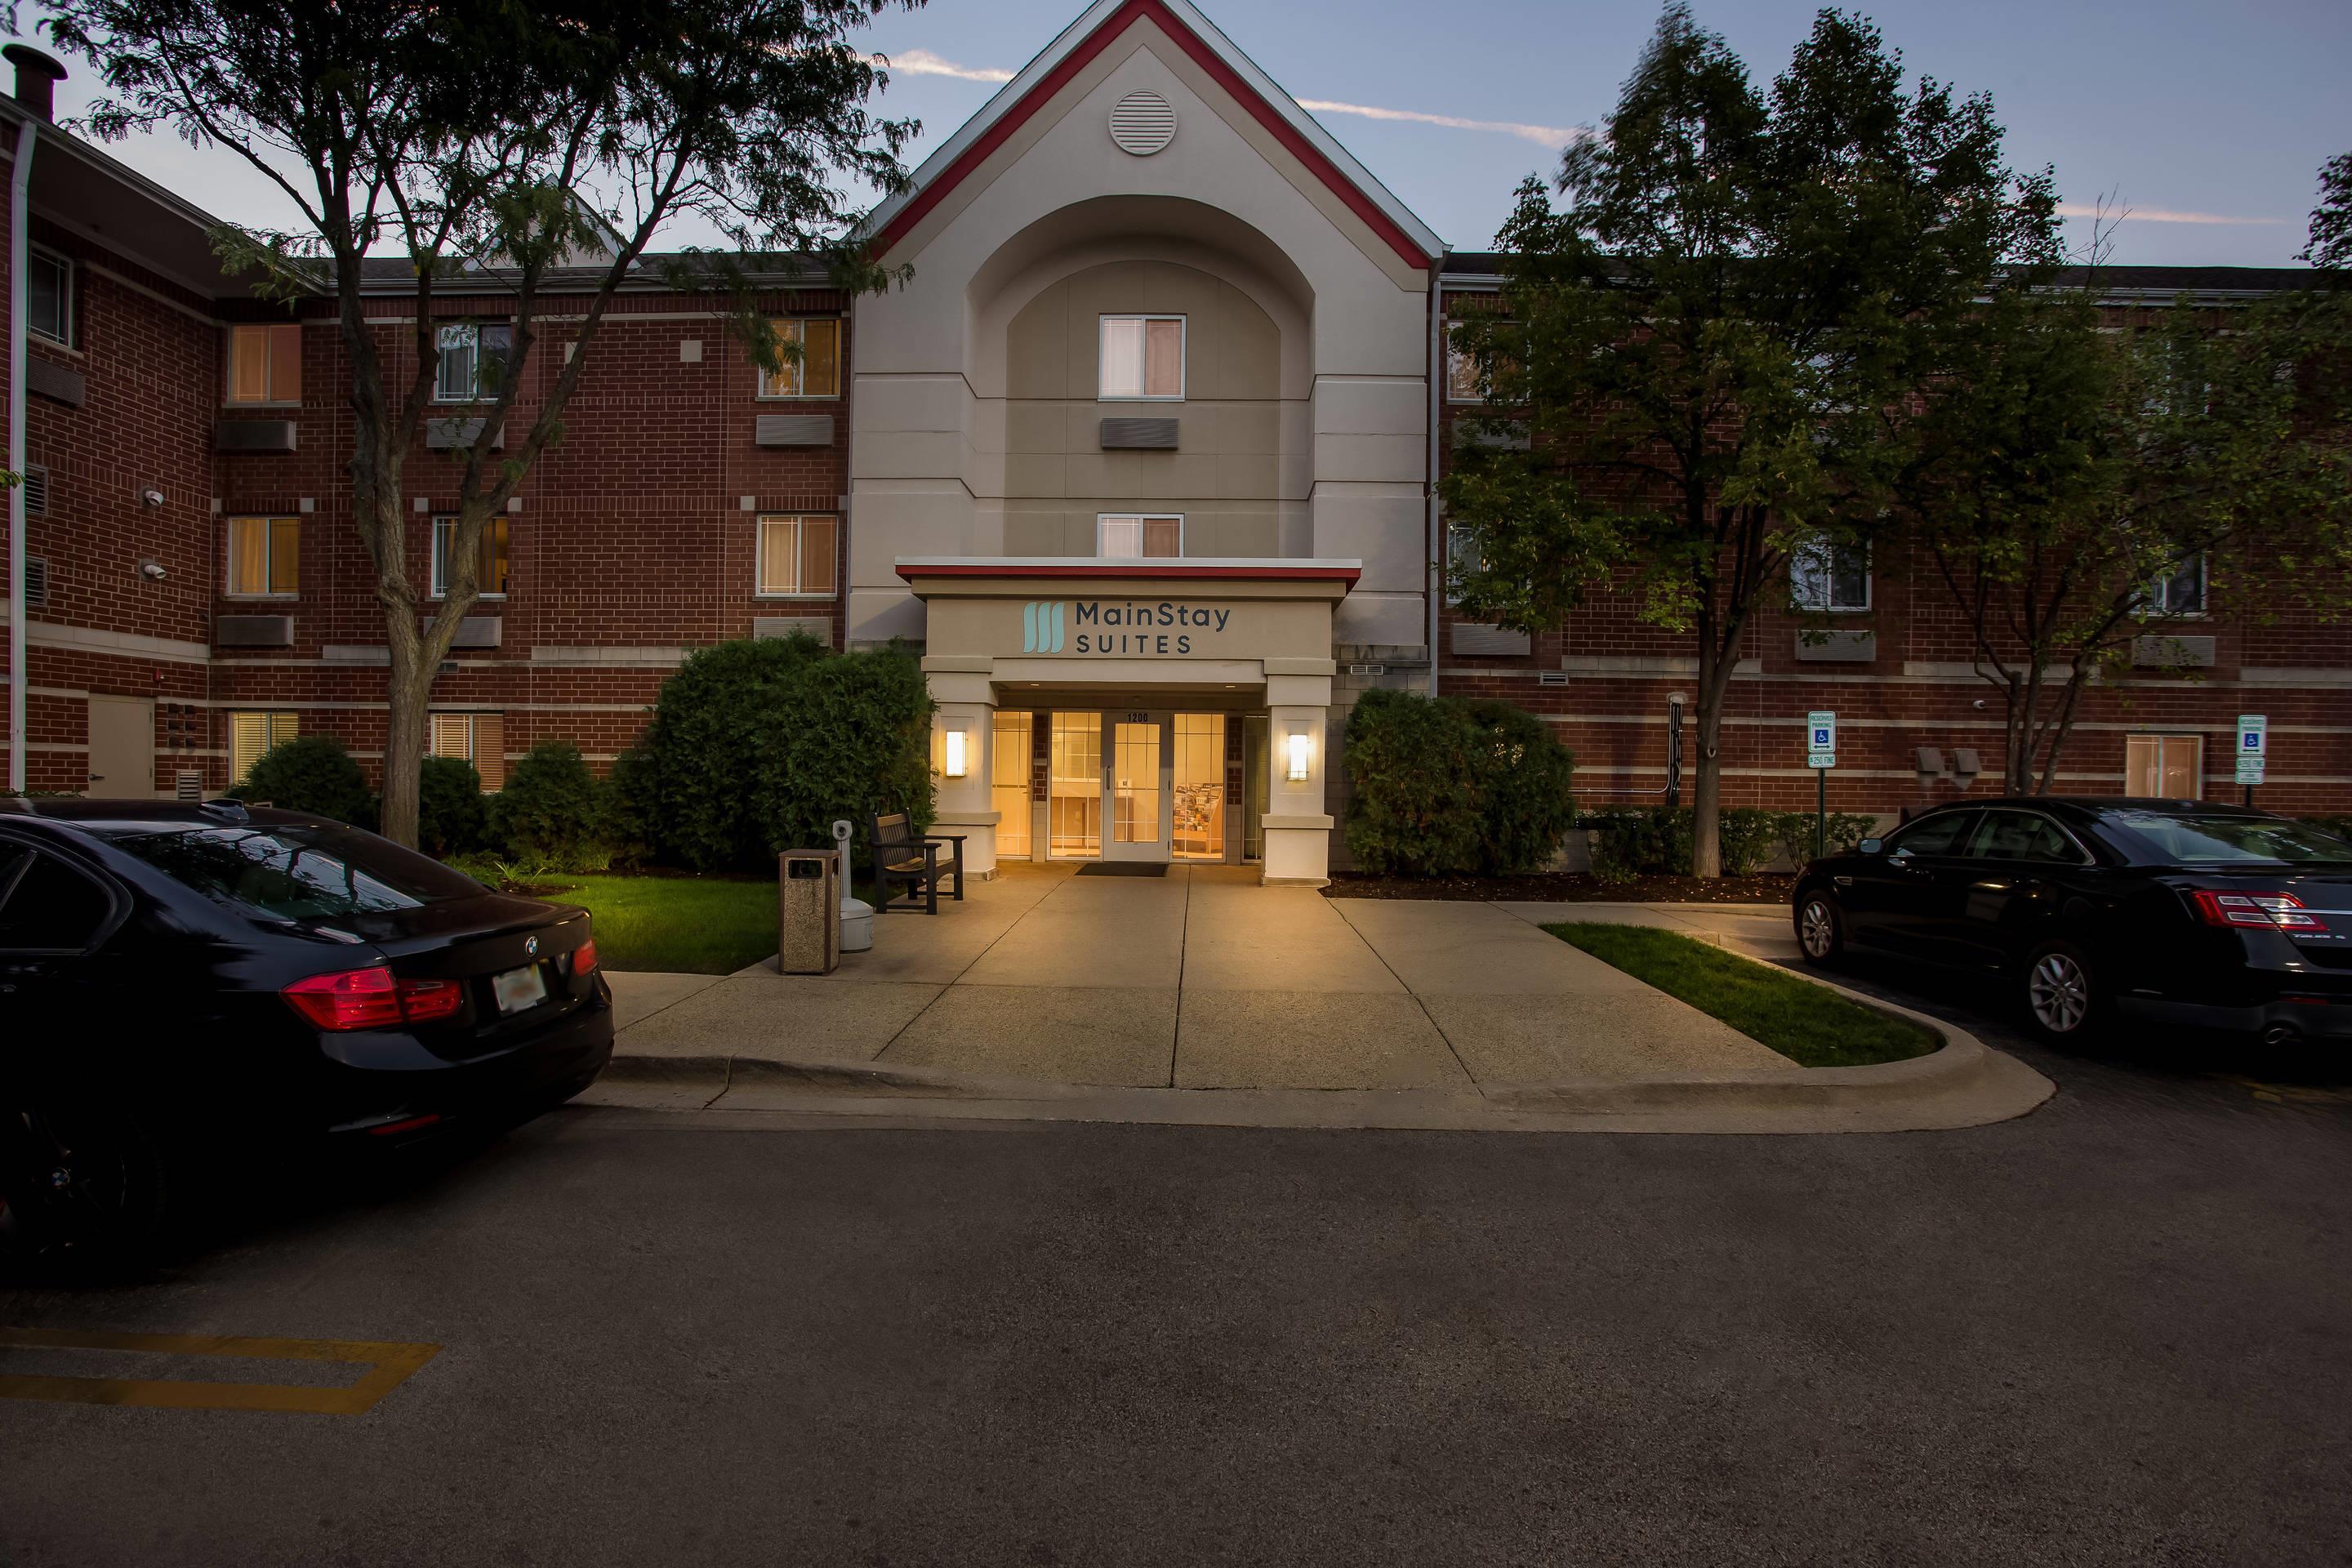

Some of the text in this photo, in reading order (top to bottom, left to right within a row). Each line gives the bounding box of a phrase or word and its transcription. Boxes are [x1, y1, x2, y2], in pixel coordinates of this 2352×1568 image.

[1076, 602, 1231, 632] MainStay
[1076, 635, 1191, 654] SUITES
[1128, 712, 1148, 723] 1200
[1810, 756, 1834, 764] $250 FINE
